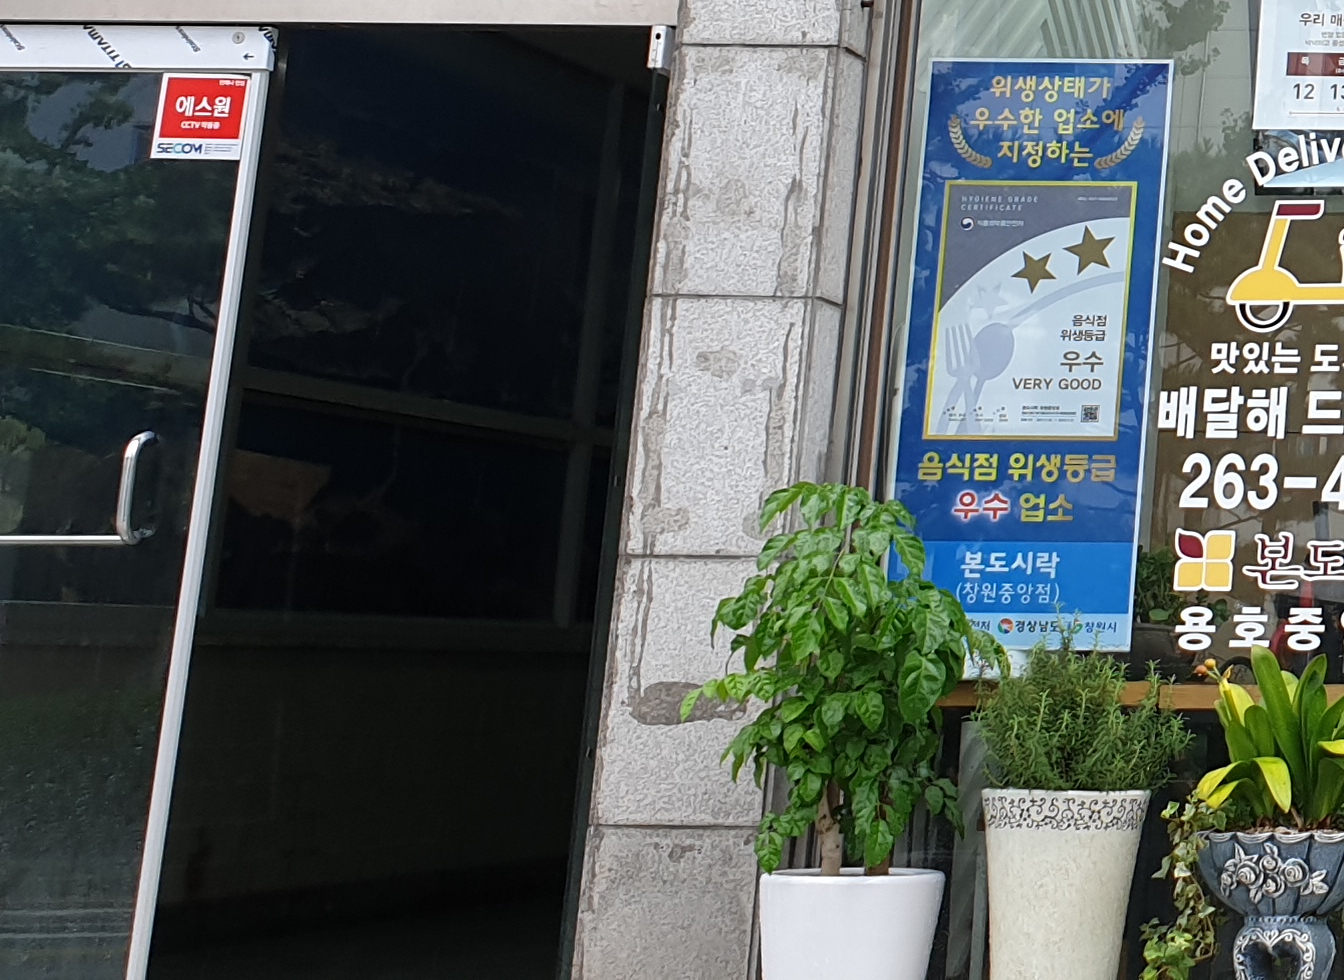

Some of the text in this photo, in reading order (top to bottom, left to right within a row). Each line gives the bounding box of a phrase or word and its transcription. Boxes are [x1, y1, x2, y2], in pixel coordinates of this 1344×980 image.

[1298, 12, 1325, 27] 우리
[990, 75, 1112, 104] 위생상태가
[1292, 82, 1315, 101] 12
[175, 95, 232, 118] 에스원
[969, 107, 1125, 135] 우수한 업소에
[156, 142, 203, 155] SECOM
[996, 140, 1097, 169] 지정하는
[960, 204, 1023, 212] CERTIFICATE
[1161, 177, 1247, 274] Home
[1071, 314, 1108, 327] 음식점
[1060, 329, 1106, 342] 위생등급
[1060, 351, 1104, 373] 우수
[1209, 341, 1302, 375] 맛있는
[1012, 377, 1102, 390] VERY GOOD
[1157, 385, 1290, 440] 배달해
[917, 451, 1117, 484] 음식점 위생등급
[952, 490, 1075, 523] 우수 업소
[960, 551, 1061, 579] 본도시락
[955, 582, 1061, 604] (창원중앙점)
[1015, 620, 1060, 633] 경상남도
